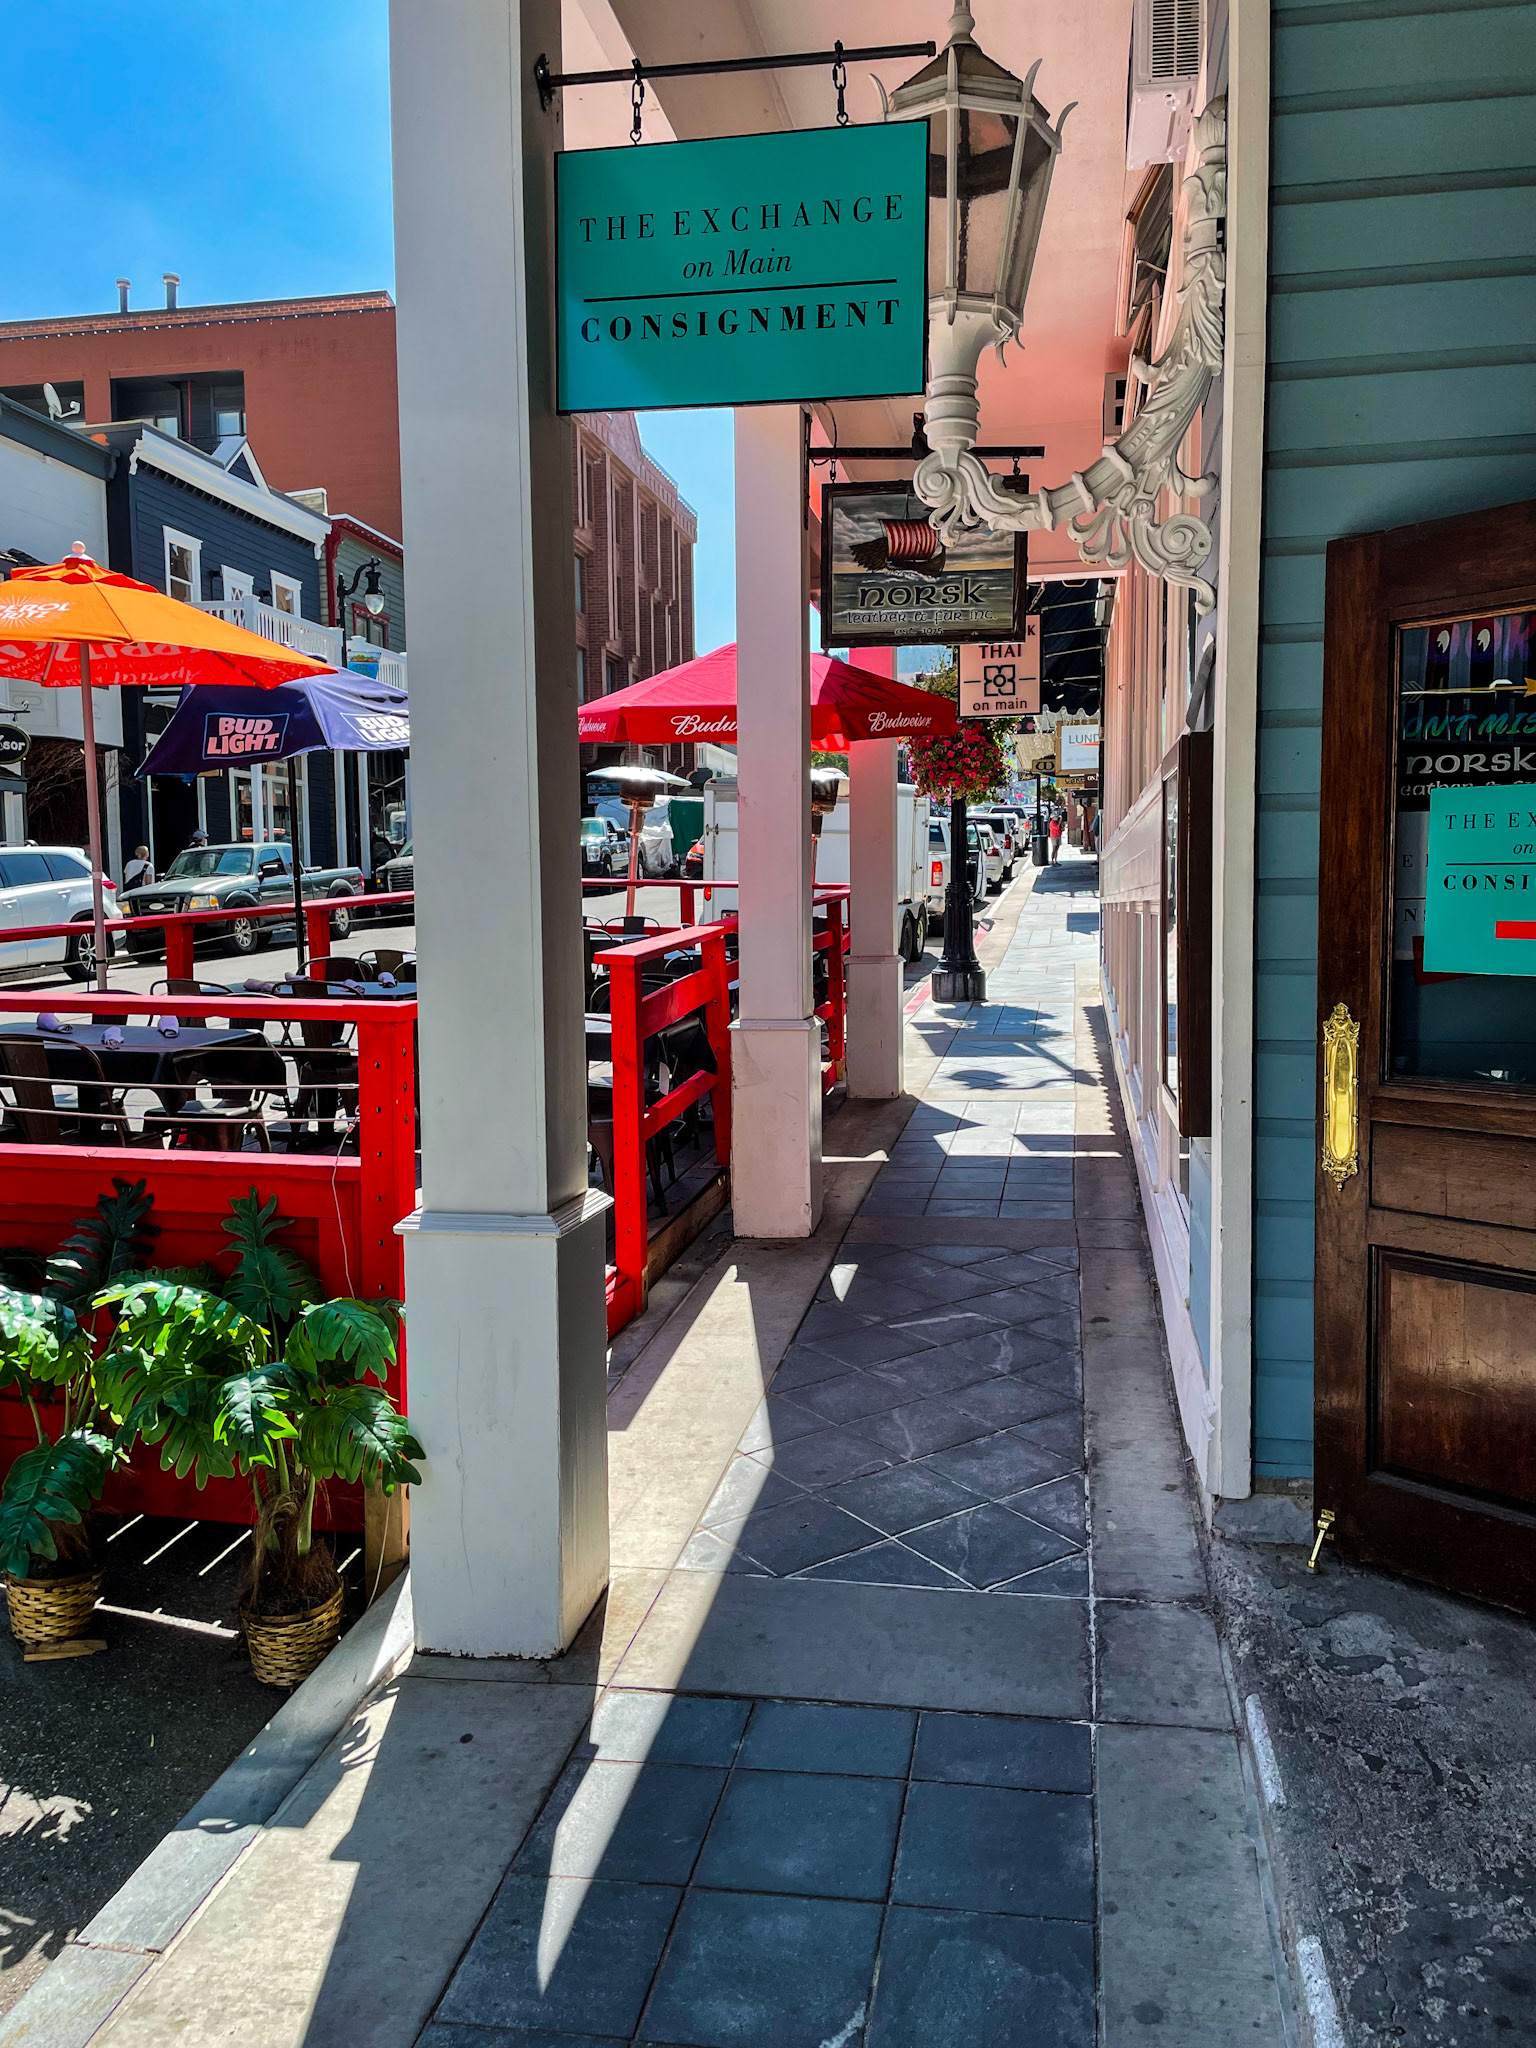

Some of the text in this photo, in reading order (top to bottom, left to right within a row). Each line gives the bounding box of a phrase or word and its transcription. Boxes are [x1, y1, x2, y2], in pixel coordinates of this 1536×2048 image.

[579, 194, 903, 242] THE EXCHANGE
[682, 248, 793, 279] on Main
[581, 299, 900, 343] CONSIGNMENT
[0, 609, 49, 620] RITZ
[978, 644, 1022, 659] THAI
[972, 698, 1028, 711] on main
[218, 717, 273, 736] BUD
[354, 715, 404, 730] BUD
[867, 711, 933, 733] Budweiser
[0, 741, 26, 751] sor
[206, 733, 280, 754] LIGHT
[1445, 813, 1496, 830] THE
[1512, 843, 1535, 855] on
